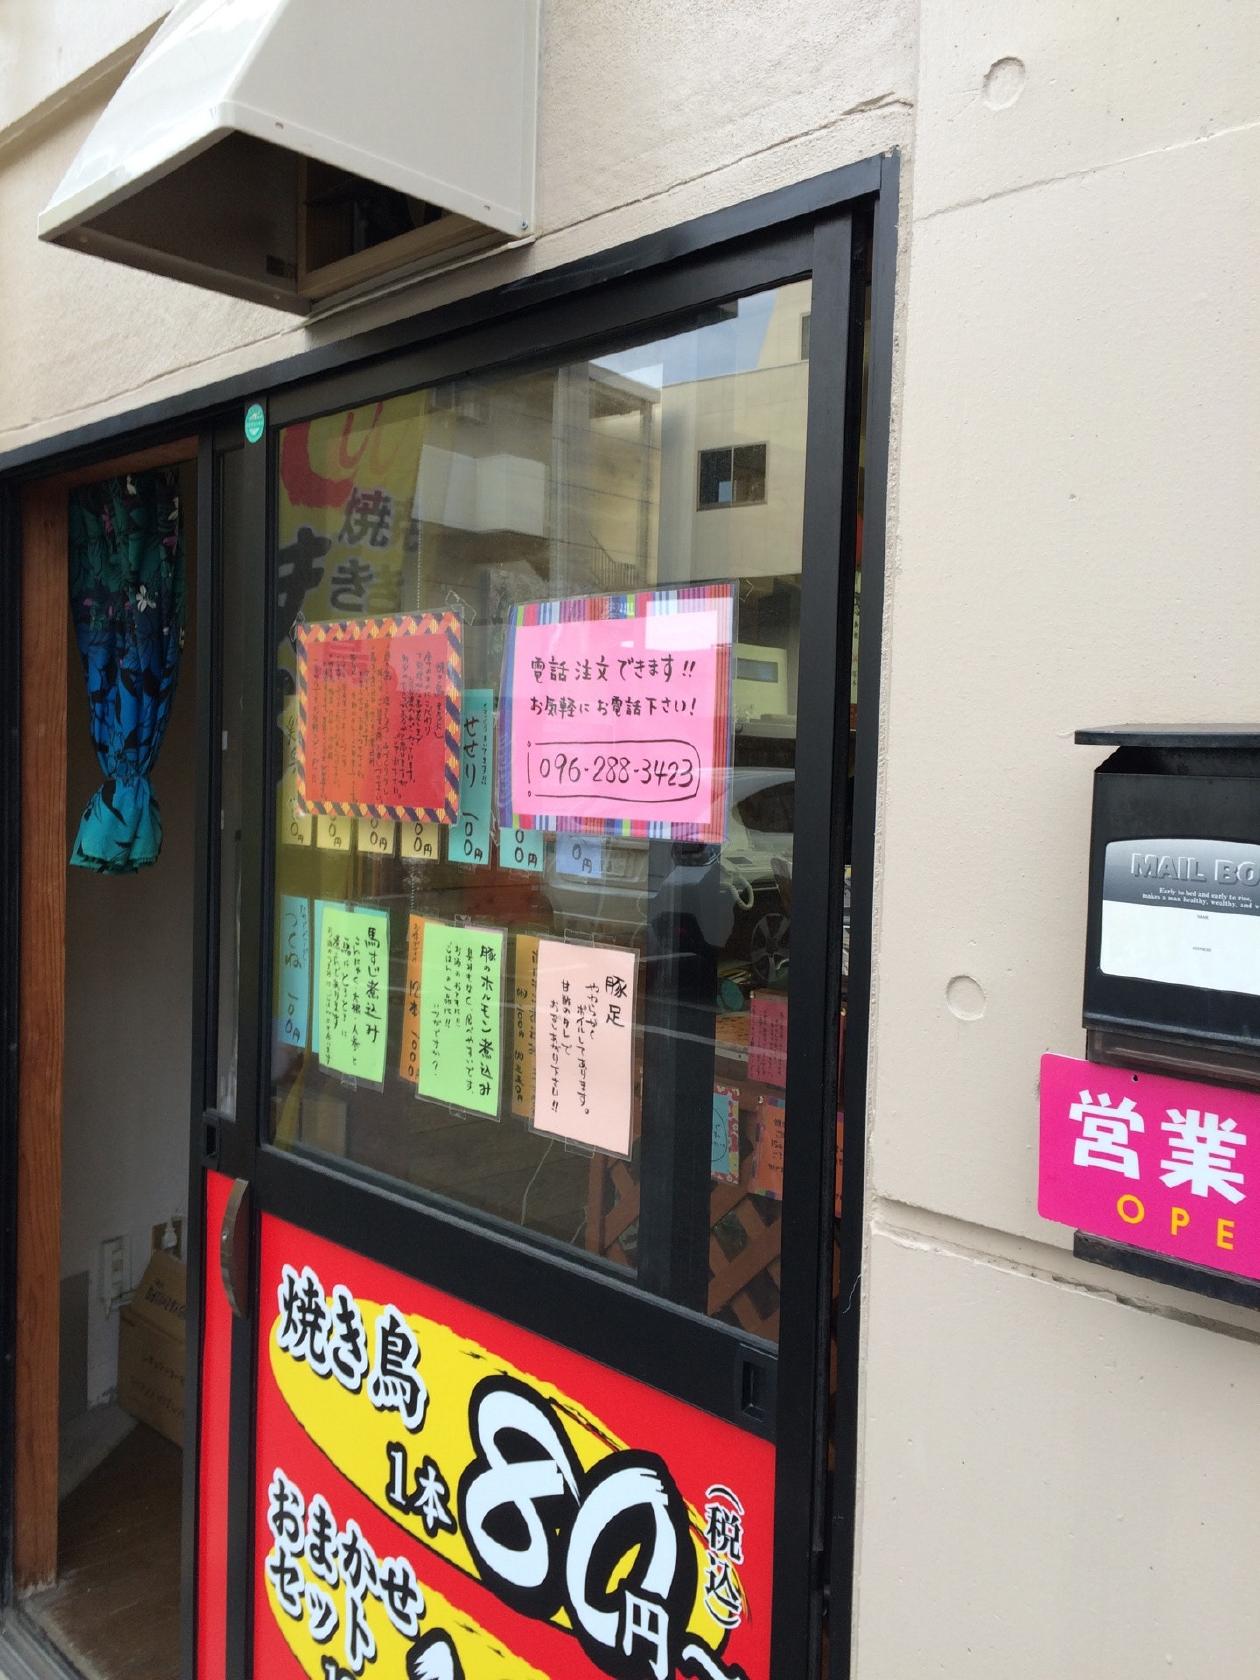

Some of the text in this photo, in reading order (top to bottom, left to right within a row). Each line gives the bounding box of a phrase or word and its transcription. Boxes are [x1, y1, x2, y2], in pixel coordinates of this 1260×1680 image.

[463, 716, 479, 788] せせり
[539, 753, 694, 788] 096-288-3423
[1131, 853, 1207, 883] MAIL
[1142, 892, 1161, 900] makes
[1240, 901, 1252, 909] and
[1159, 887, 1176, 896] Early
[1186, 889, 1197, 897] bed
[478, 945, 497, 1096] 豚のホルモン煮込み
[584, 981, 600, 1040] やわらかく
[605, 975, 628, 1028] 豚足
[1068, 1089, 1247, 1206] 営業
[279, 1266, 426, 1430] 焼き鳥
[386, 1445, 458, 1535] 1本
[269, 1469, 426, 1638] おまかせ
[705, 1484, 746, 1628] (税込)
[267, 1556, 378, 1674] セット
